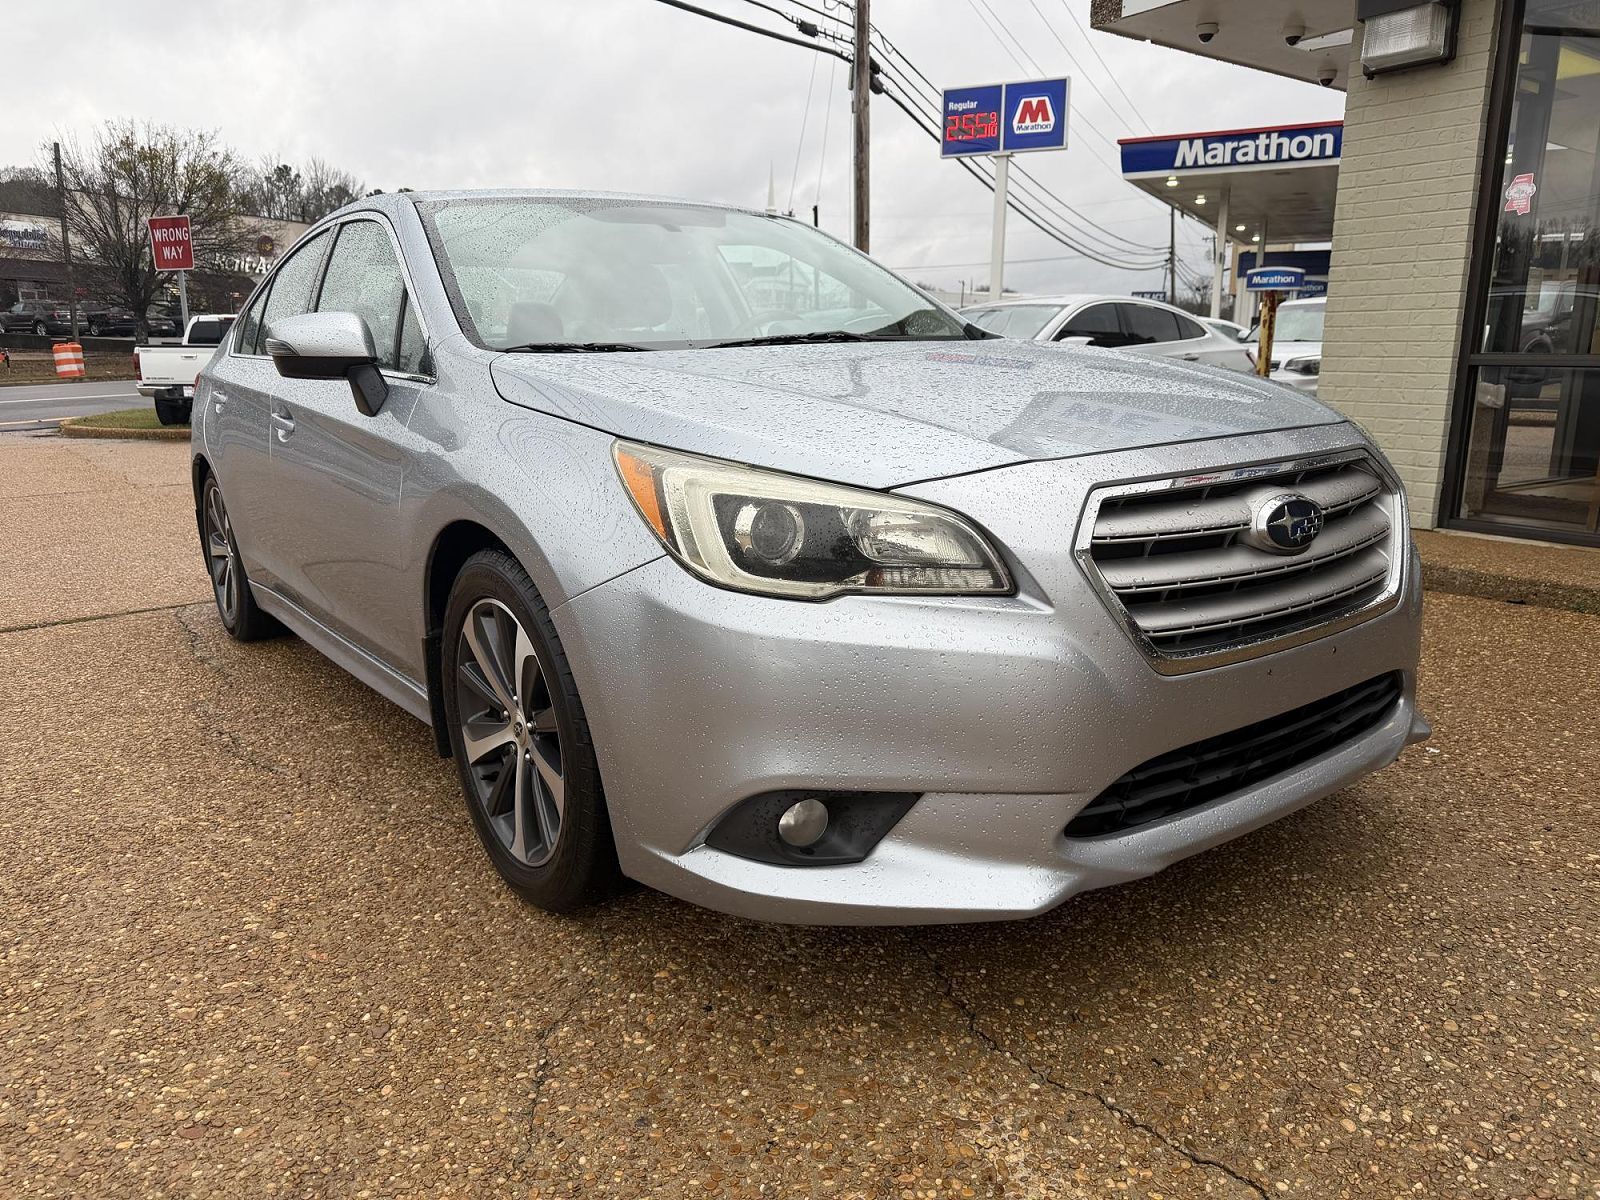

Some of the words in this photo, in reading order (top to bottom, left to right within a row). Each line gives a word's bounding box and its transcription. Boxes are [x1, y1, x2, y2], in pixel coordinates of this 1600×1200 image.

[948, 100, 978, 111] Regular
[1016, 123, 1051, 131] Marathon
[1174, 132, 1334, 167] Marathon
[153, 228, 189, 242] WRONG
[162, 246, 184, 260] WAY
[1252, 274, 1295, 284] Marathon
